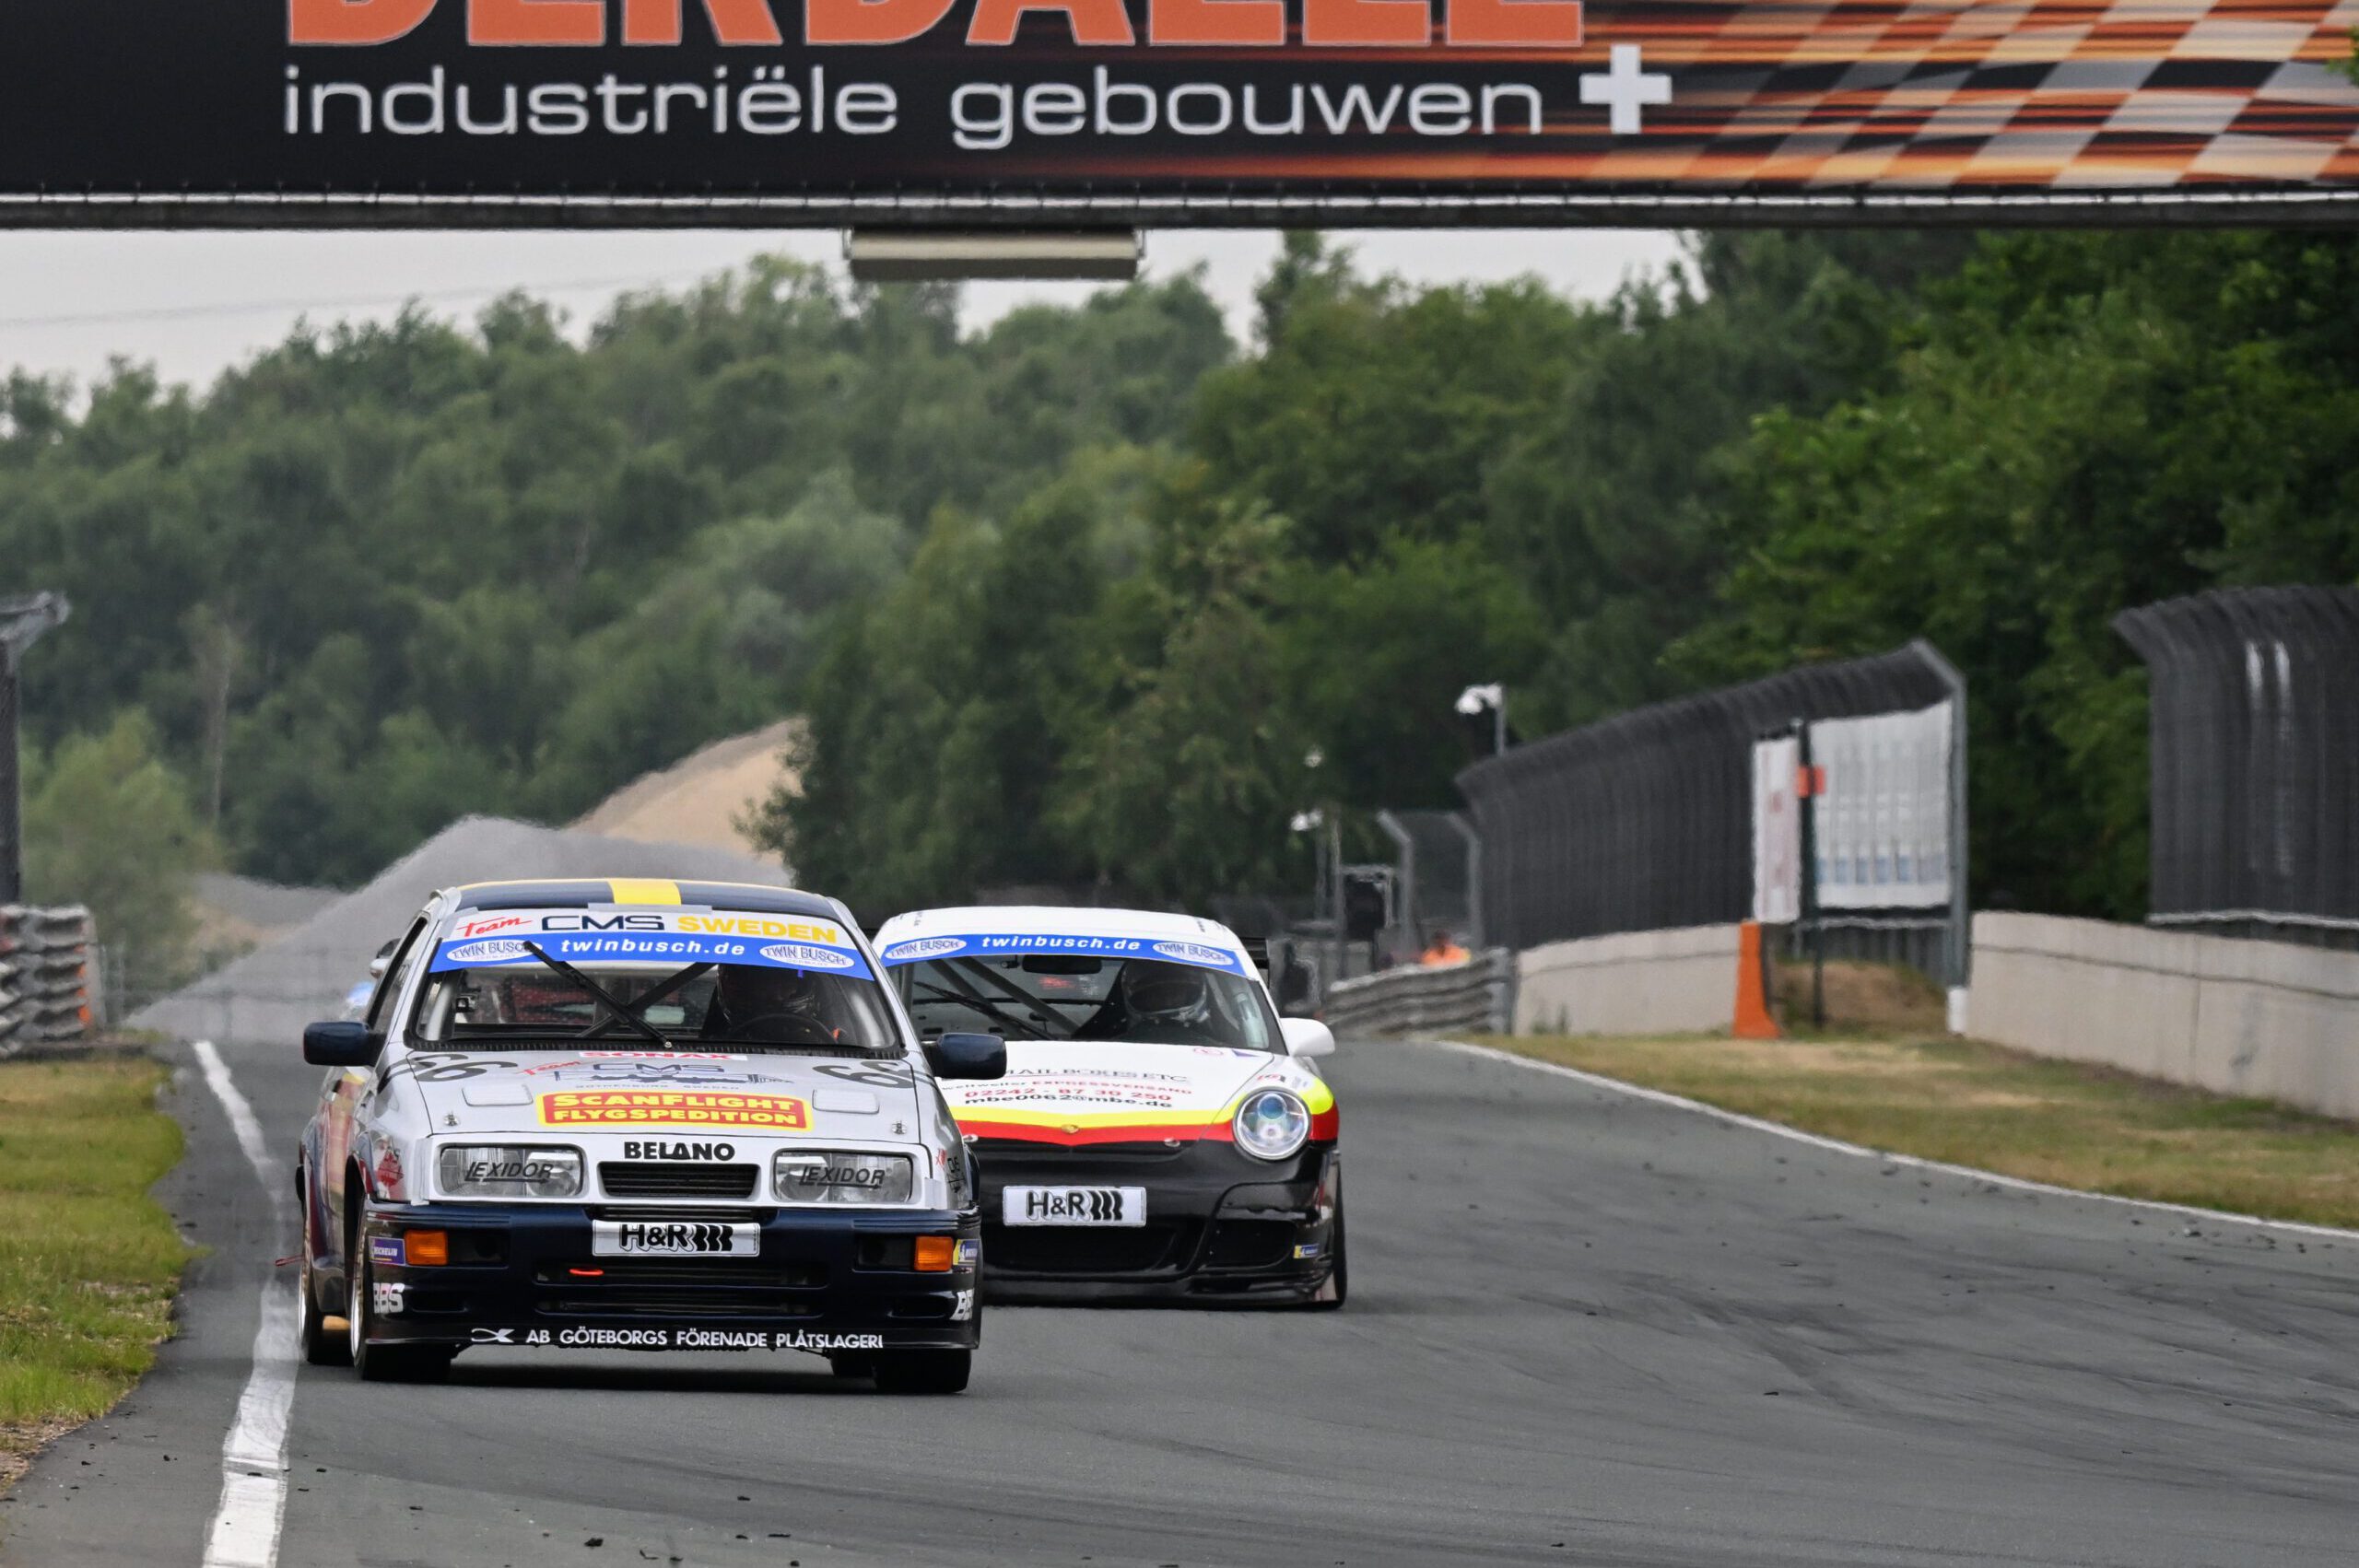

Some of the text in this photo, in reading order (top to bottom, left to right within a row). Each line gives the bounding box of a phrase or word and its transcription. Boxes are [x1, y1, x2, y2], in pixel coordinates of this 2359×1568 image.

[284, 65, 1543, 150] industriële gebouwen
[457, 915, 837, 943] Team CMS SWEDEN
[452, 945, 484, 957] TWIN
[488, 941, 528, 953] BUSC
[561, 939, 745, 955] twinbusch.de
[891, 941, 960, 957] TWIN BUSCH
[982, 936, 1141, 951] twinbusch.de
[1156, 942, 1226, 962] TWIN BUSCH
[765, 947, 797, 958] TWIN
[800, 948, 847, 965] BUSCH
[965, 1088, 1036, 1098] 02242
[1131, 1092, 1171, 1101] 250
[965, 1094, 1172, 1107] mbe0062@mbe.de
[555, 1109, 797, 1125] FLYGSPEDITION
[624, 1141, 735, 1161] BELANO
[464, 1161, 554, 1181] LEXIDOR
[799, 1164, 885, 1187] LEXIDOR
[1027, 1190, 1091, 1221] H&R
[620, 1223, 695, 1252] H&R
[525, 1326, 883, 1348] AB GÖTEBORGS FÖRENADE PLÅTSLAGERI
